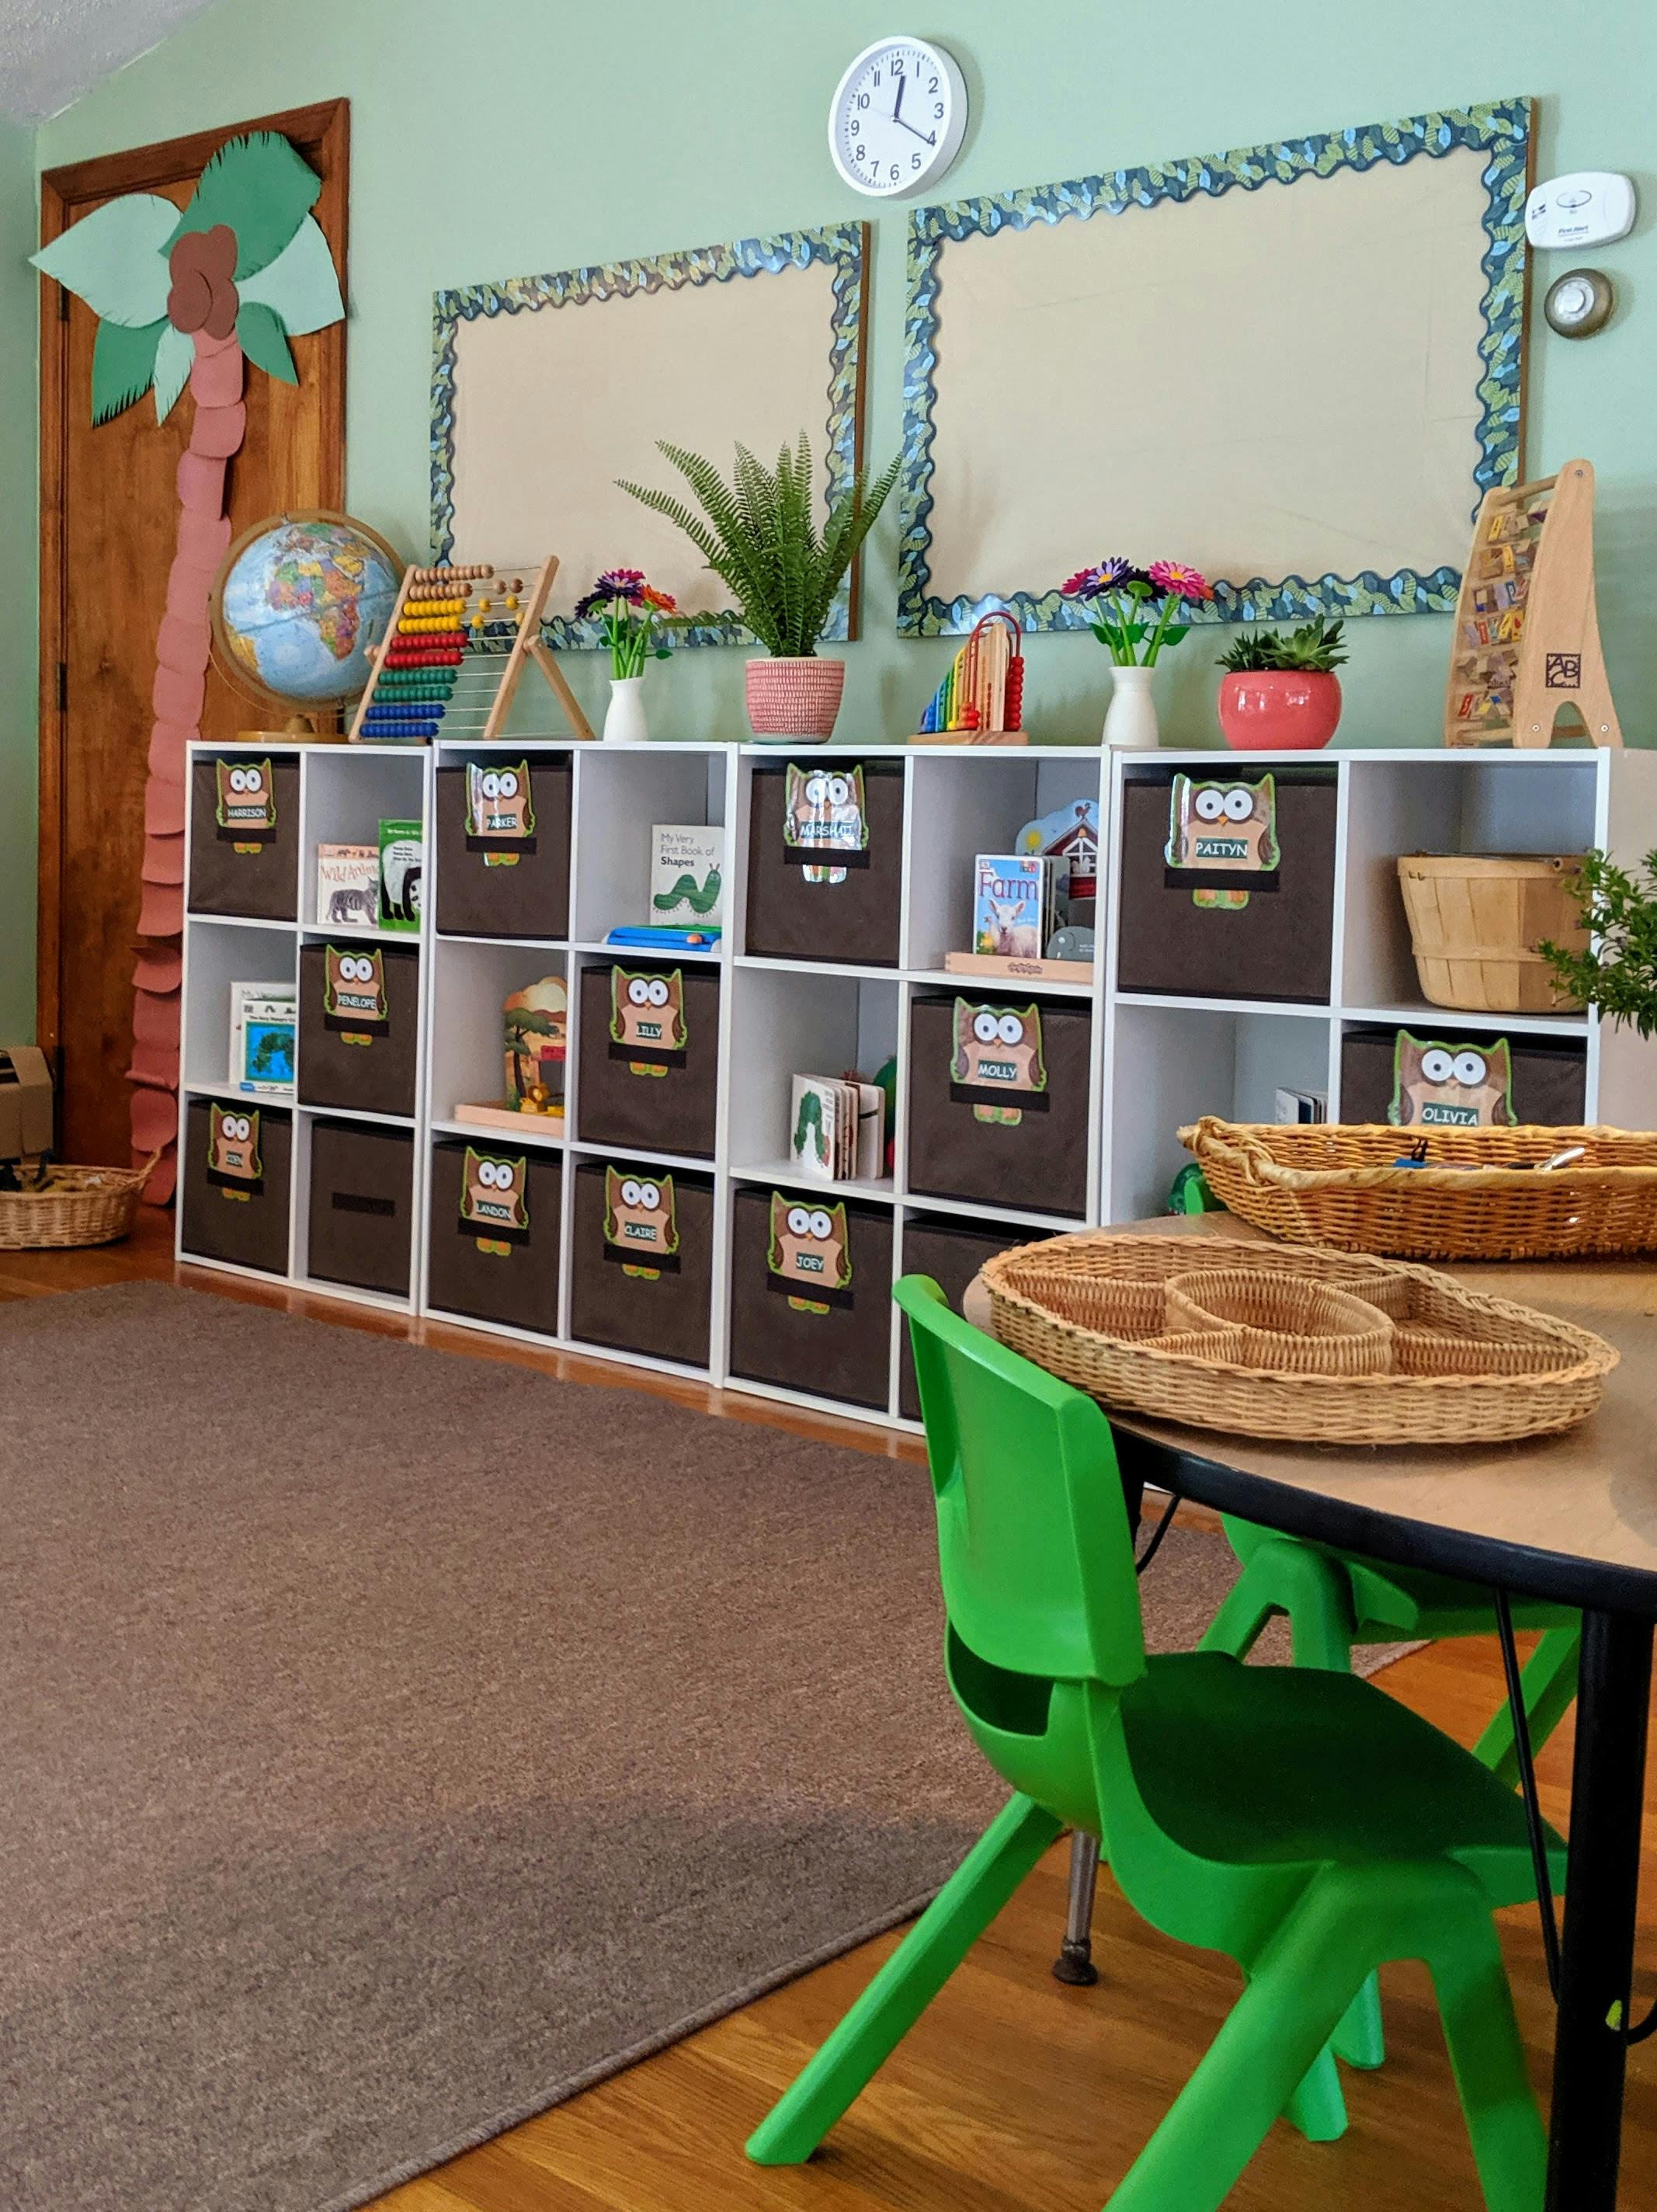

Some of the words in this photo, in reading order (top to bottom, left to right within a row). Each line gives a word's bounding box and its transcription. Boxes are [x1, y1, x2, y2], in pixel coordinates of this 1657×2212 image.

[891, 59, 904, 76] 12
[916, 61, 920, 78] 1
[874, 70, 881, 87] 11
[928, 77, 939, 94] 2
[857, 93, 870, 110] 10
[933, 103, 944, 119] 3
[850, 120, 860, 136] 9
[927, 130, 937, 146] 4
[856, 144, 866, 161] 8
[870, 161, 880, 177] 7
[911, 153, 922, 170] 5
[890, 165, 900, 181] 6
[228, 807, 266, 818] HARRISON
[487, 816, 518, 829] PARKER
[661, 833, 674, 845] My
[675, 833, 695, 845] Very
[661, 844, 679, 855] First
[681, 846, 703, 856] Book
[705, 847, 715, 856] of
[1196, 842, 1248, 857] PAITYN
[661, 856, 695, 868] Shapes
[979, 871, 1039, 901] Farm
[338, 994, 377, 1009] PENELOPE
[978, 1063, 1017, 1078] MOLLY
[1422, 1108, 1478, 1125] OLIVIA
[624, 1225, 657, 1240] CLAIRE
[795, 1256, 825, 1270] JOEY
